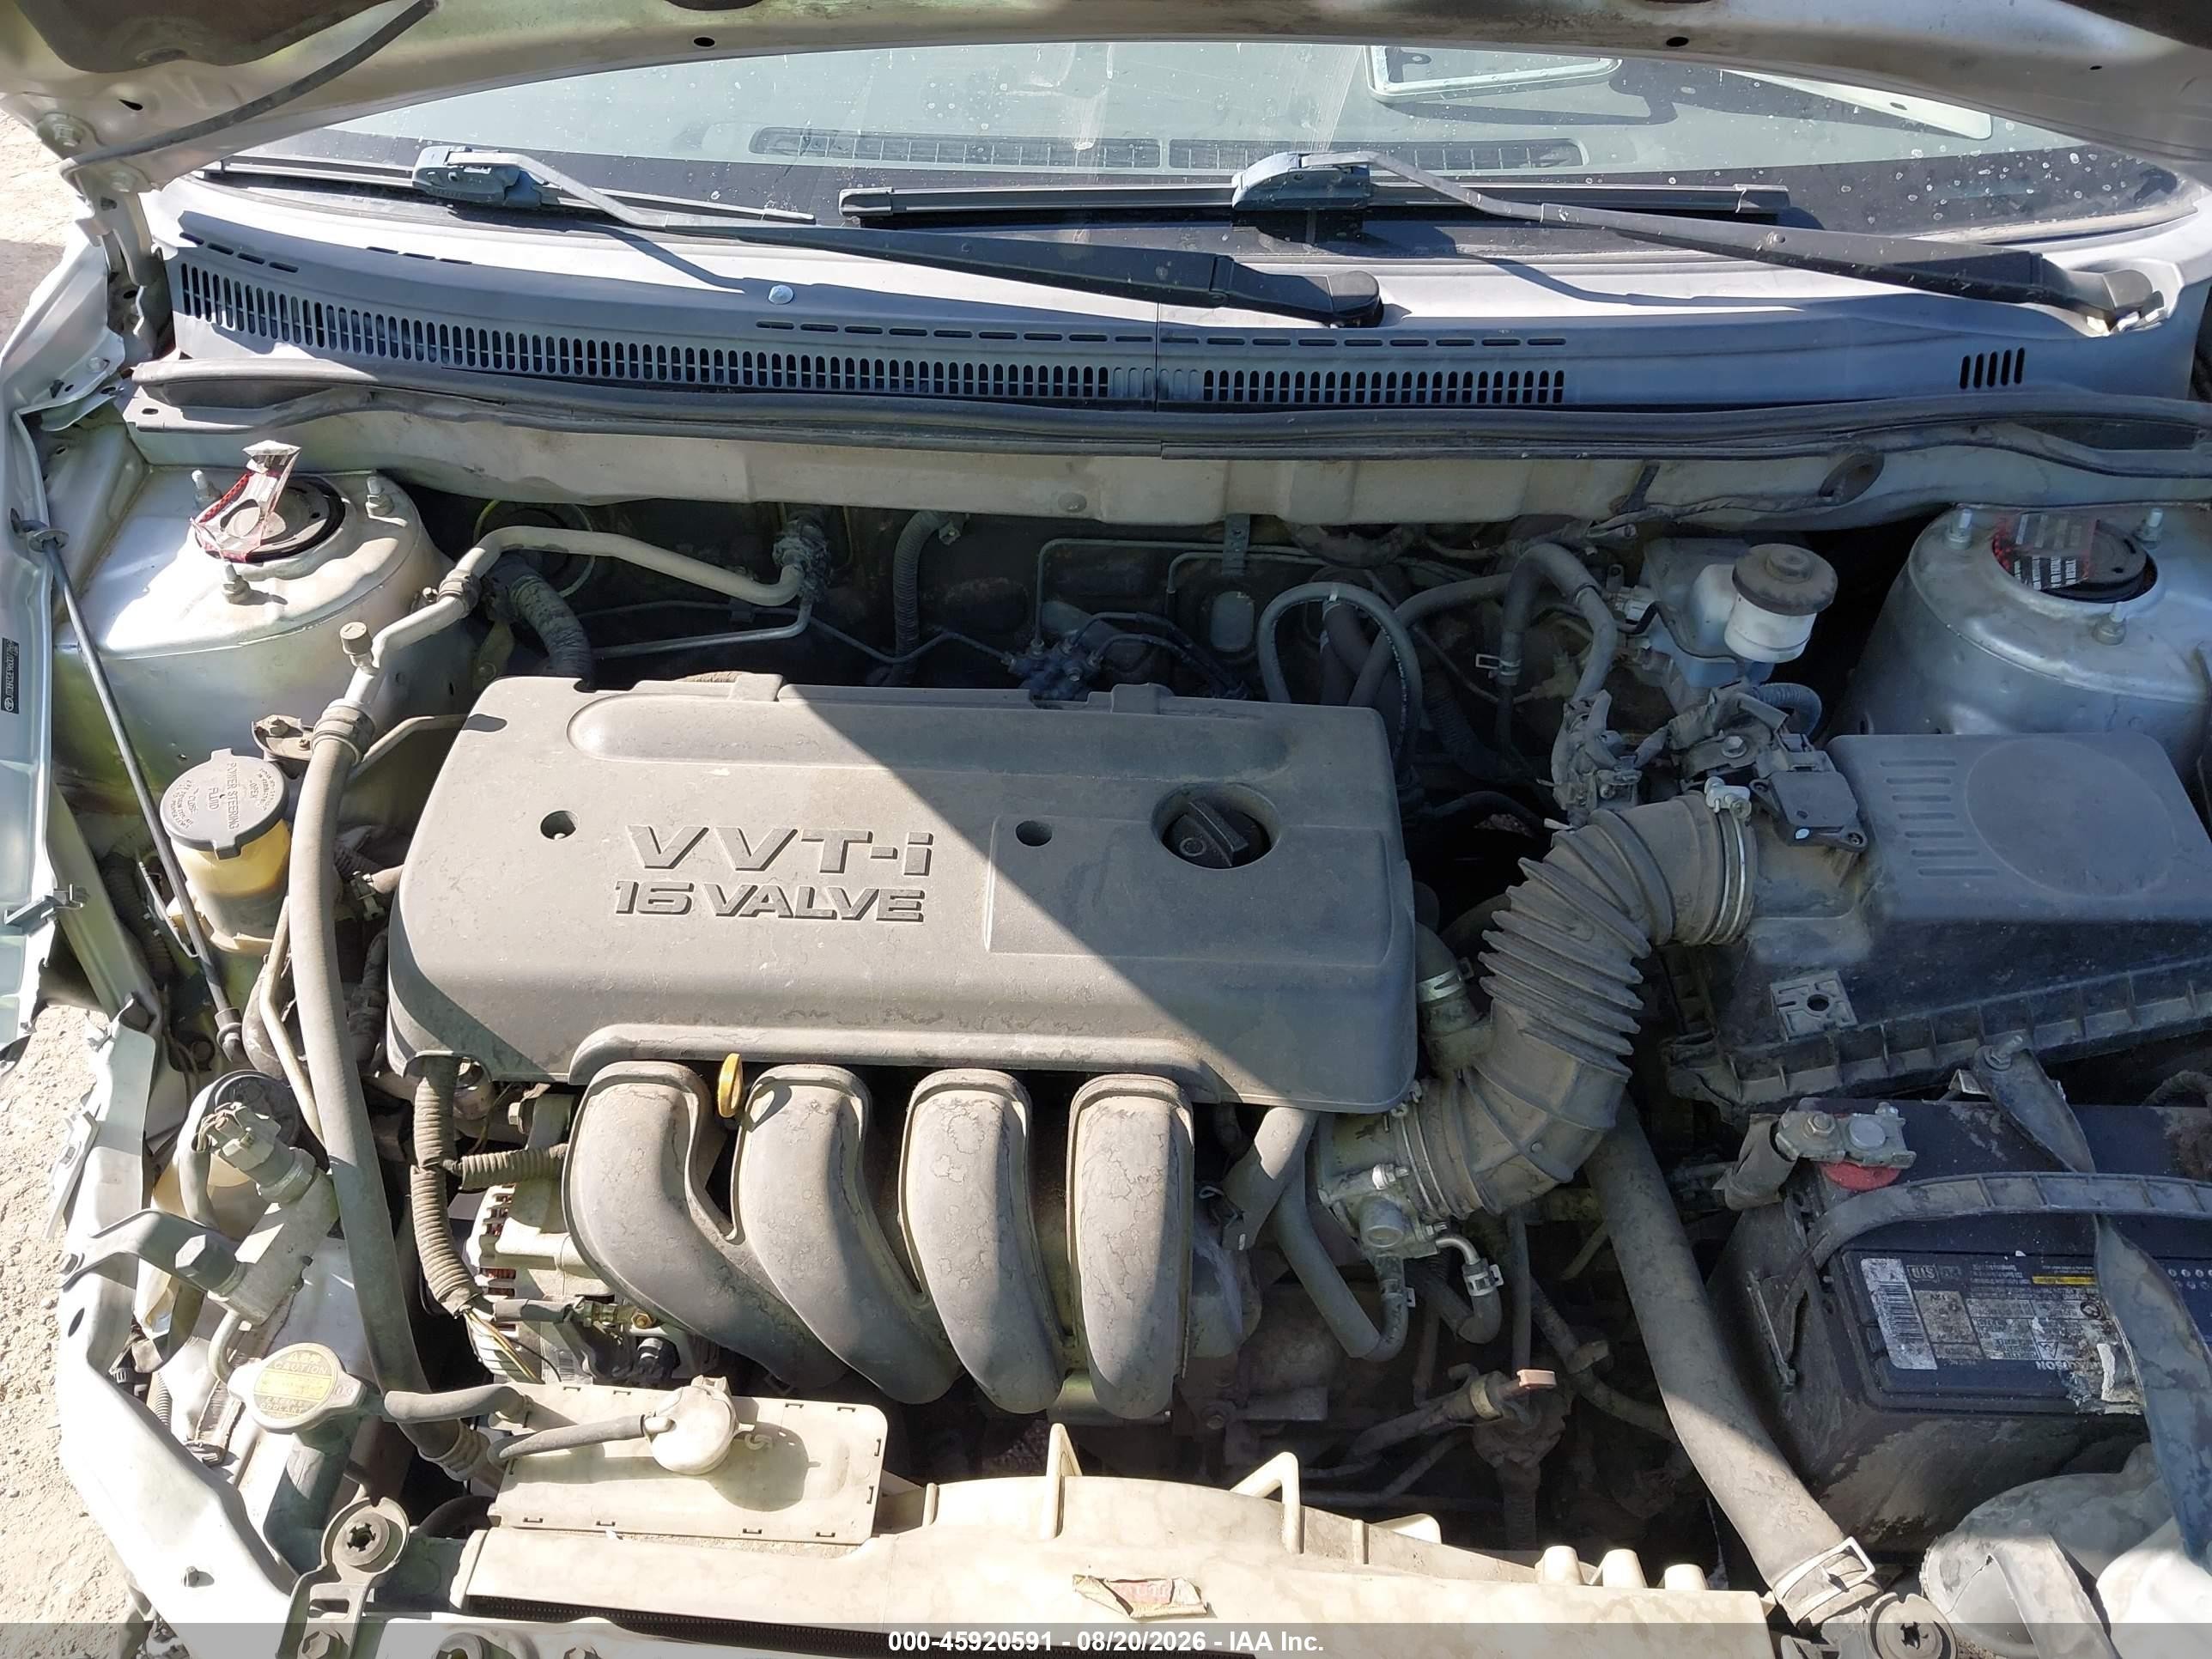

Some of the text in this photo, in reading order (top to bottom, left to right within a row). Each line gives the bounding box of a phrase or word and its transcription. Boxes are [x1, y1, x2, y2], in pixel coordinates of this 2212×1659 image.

[208, 787, 219, 810] FLUID
[227, 762, 240, 830] POWER STEERING
[626, 824, 933, 876] VVT-i
[614, 879, 925, 923] 16 VALVE
[274, 1361, 328, 1374] CAUTION
[259, 1402, 304, 1414] COOLANT
[265, 1396, 304, 1407] ENGINE
